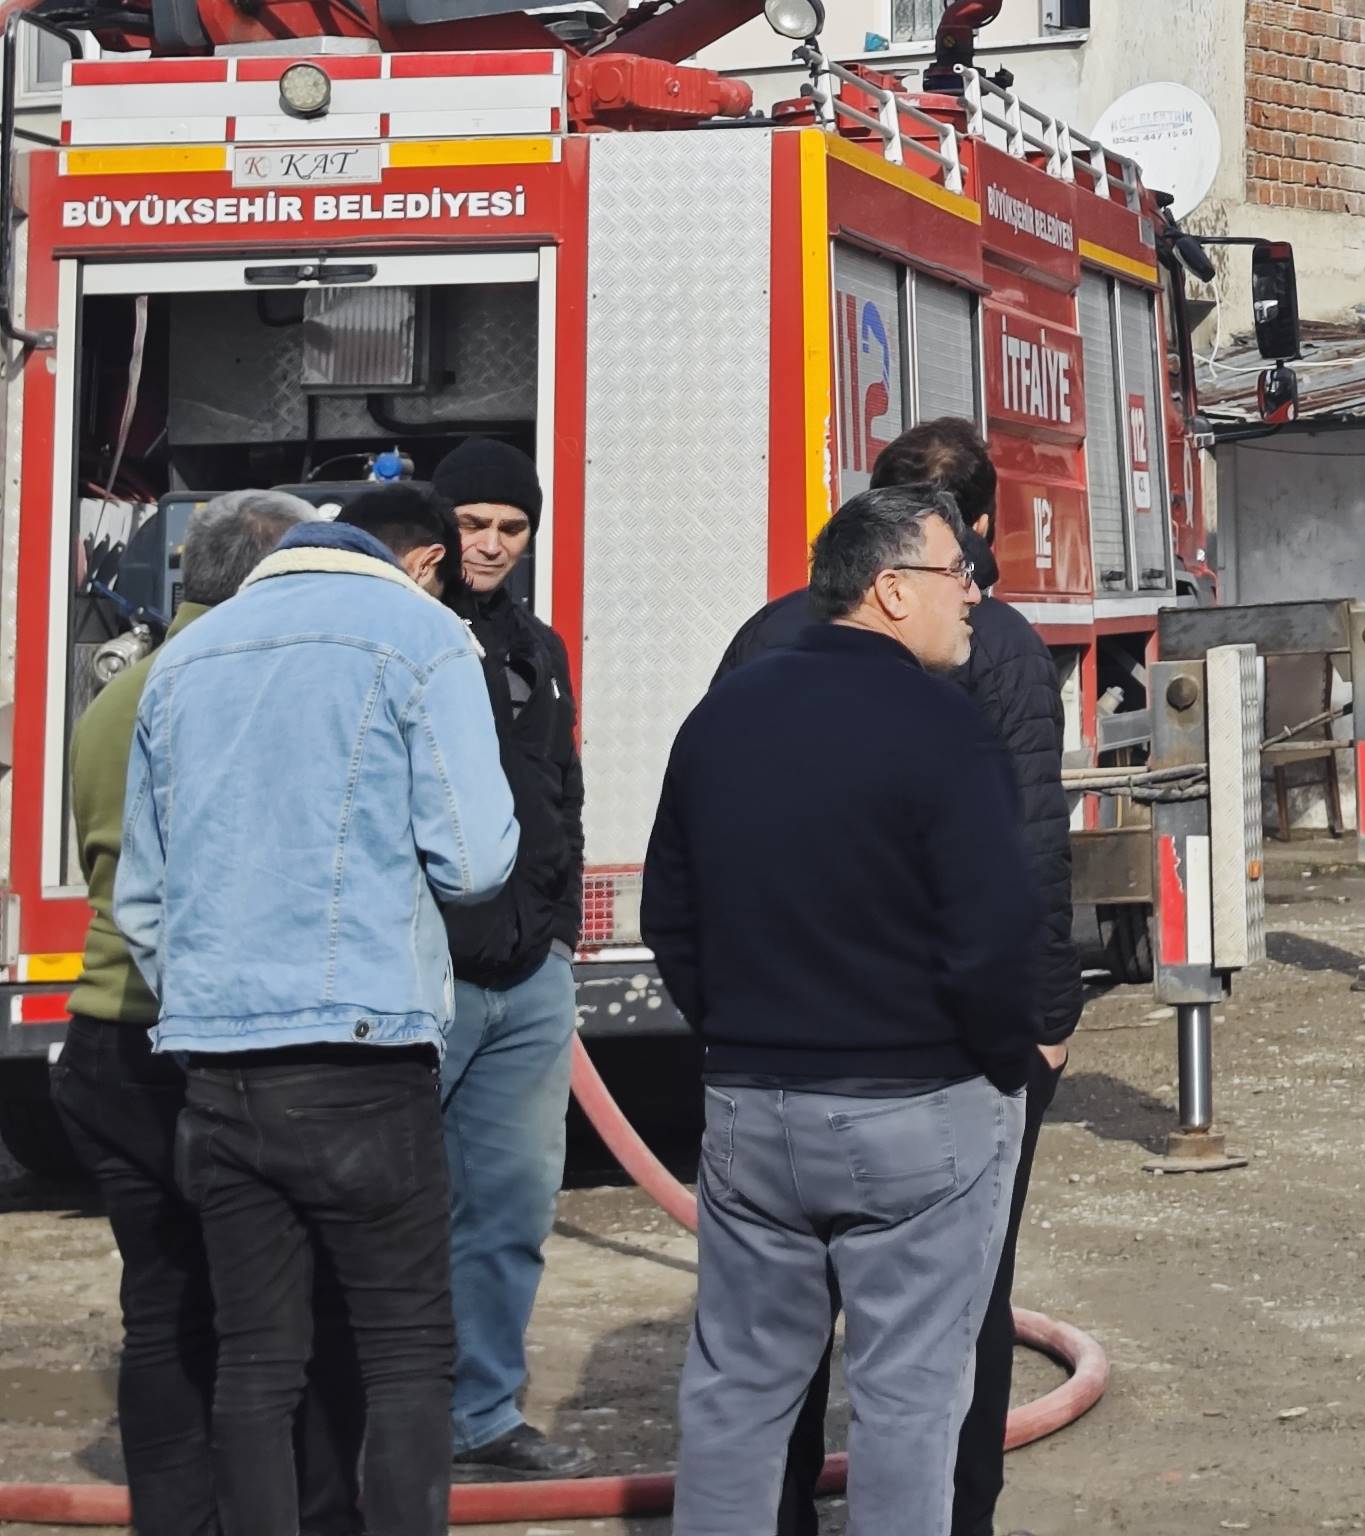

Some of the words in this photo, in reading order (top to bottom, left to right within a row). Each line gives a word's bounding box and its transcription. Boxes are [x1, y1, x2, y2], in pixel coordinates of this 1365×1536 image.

[280, 149, 359, 180] KAT
[987, 182, 1035, 236] BÜYÜKŞEHİR
[1034, 208, 1074, 252] BELEDİYESİ
[836, 289, 892, 474] 112
[1001, 314, 1072, 424] İTFAİYE
[1130, 407, 1147, 463] 112
[1033, 497, 1053, 556] 112
